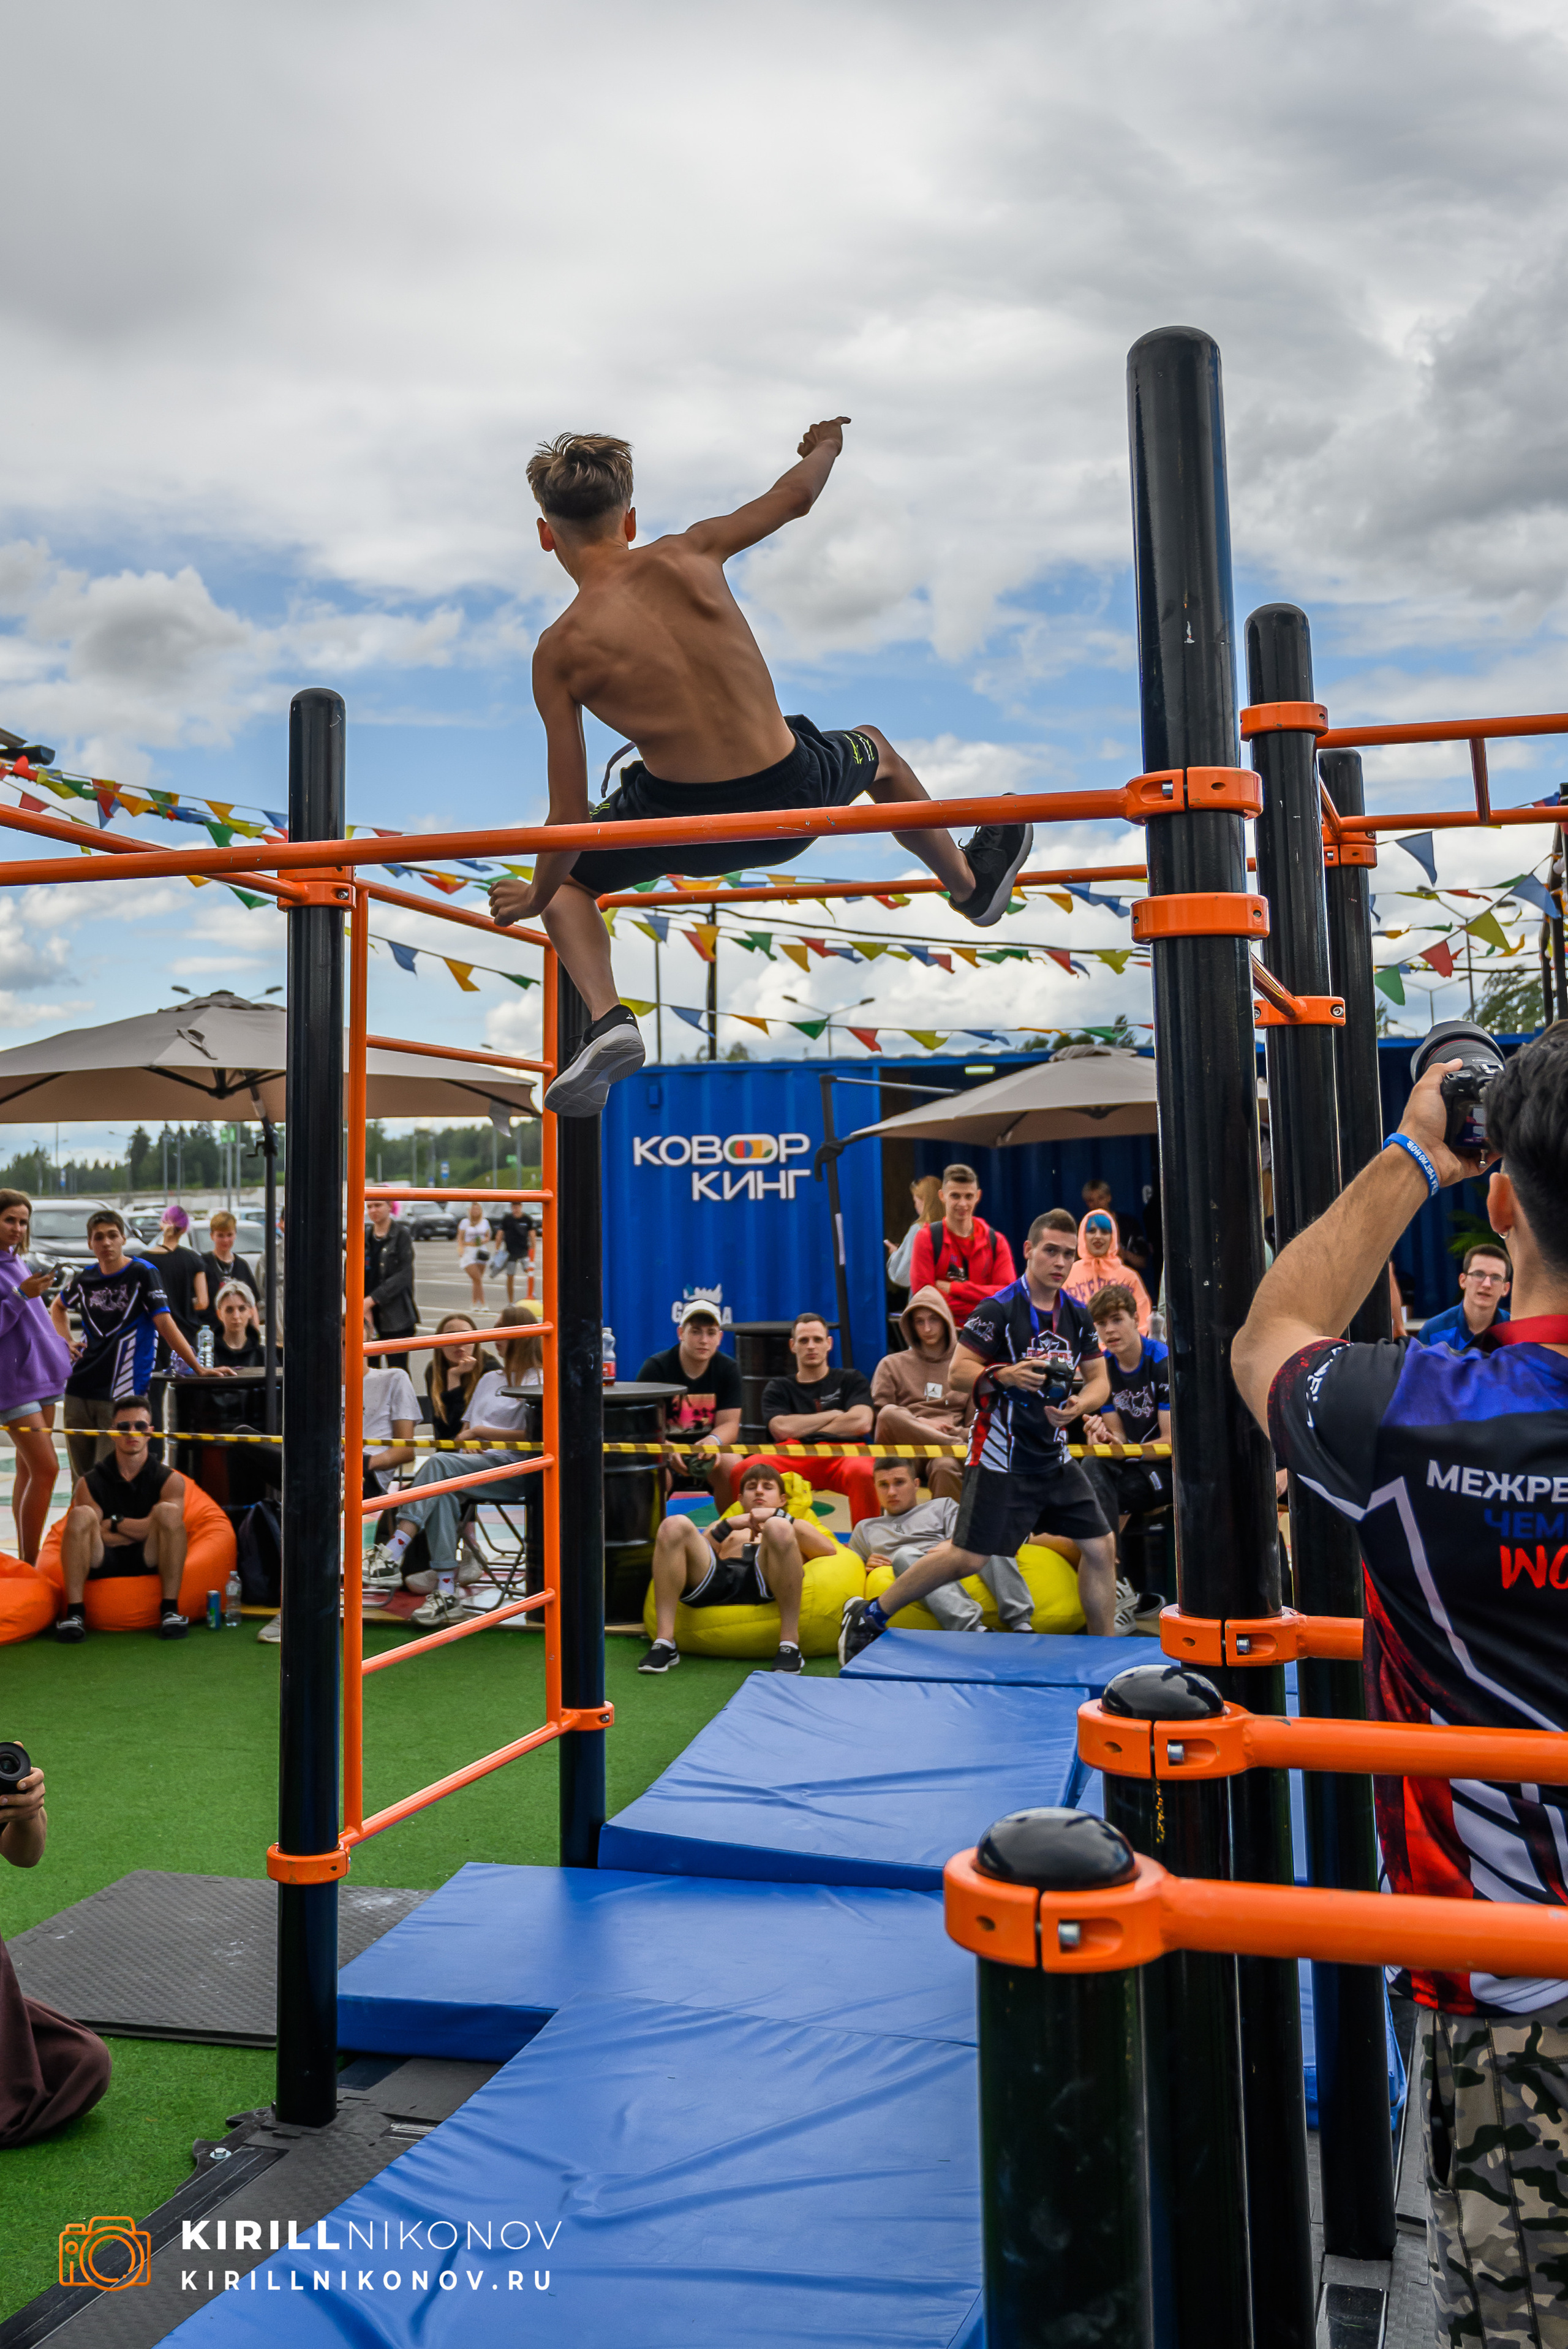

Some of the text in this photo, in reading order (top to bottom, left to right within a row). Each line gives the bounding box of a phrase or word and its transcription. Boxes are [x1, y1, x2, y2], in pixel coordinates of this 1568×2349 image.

[633, 1133, 811, 1166] КОВОР
[692, 1168, 812, 1201] КИНГ
[1483, 1508, 1568, 1539] ЧЕМ
